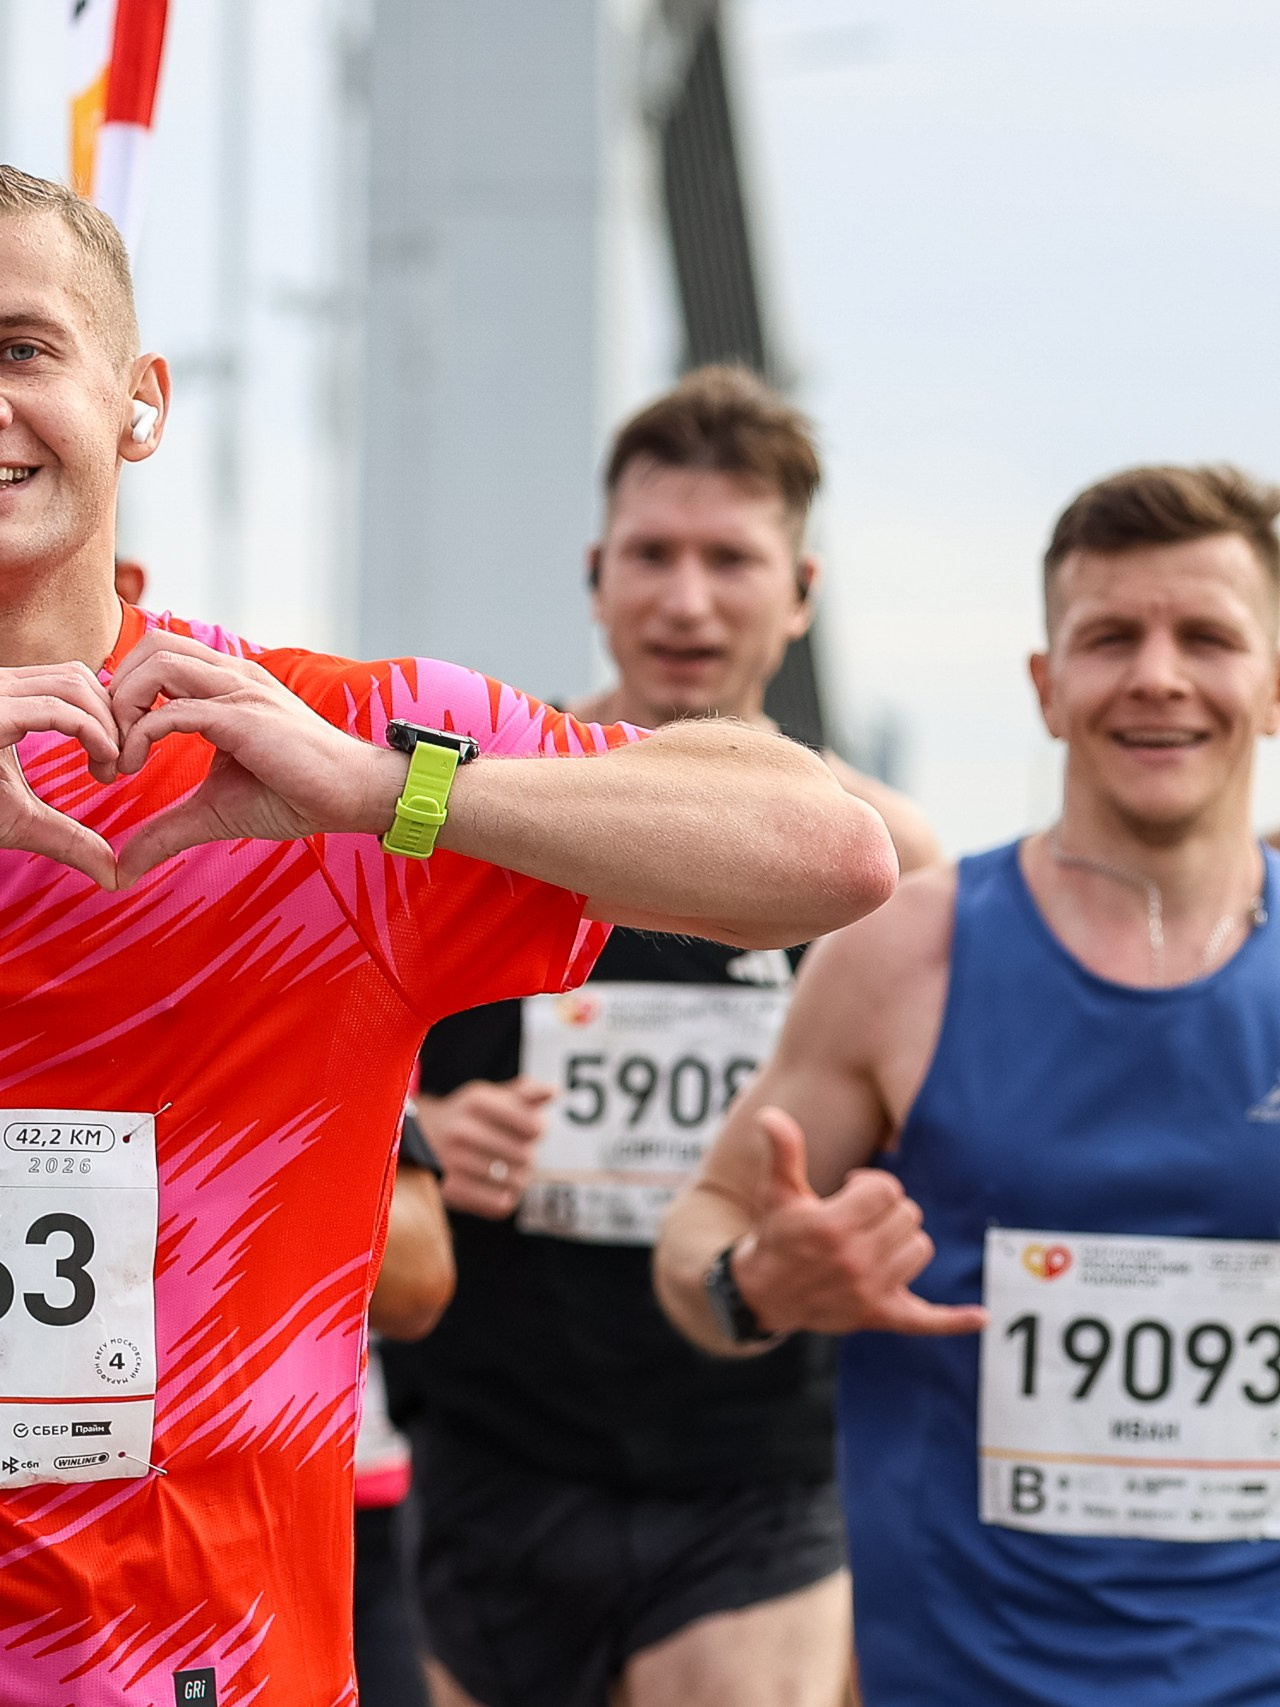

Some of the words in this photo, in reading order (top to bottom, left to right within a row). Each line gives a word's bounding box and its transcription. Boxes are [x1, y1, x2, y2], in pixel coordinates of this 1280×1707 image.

[16, 1128, 61, 1147] 42,2
[28, 1157, 92, 1174] 2026
[109, 1352, 125, 1370] 4
[1006, 1313, 1280, 1406] 19093
[32, 1425, 69, 1436] СБЕР
[75, 1424, 105, 1434] Прайм
[21, 1460, 40, 1469] сбп
[58, 1456, 98, 1467] WINLINE
[184, 1680, 206, 1700] GRi
